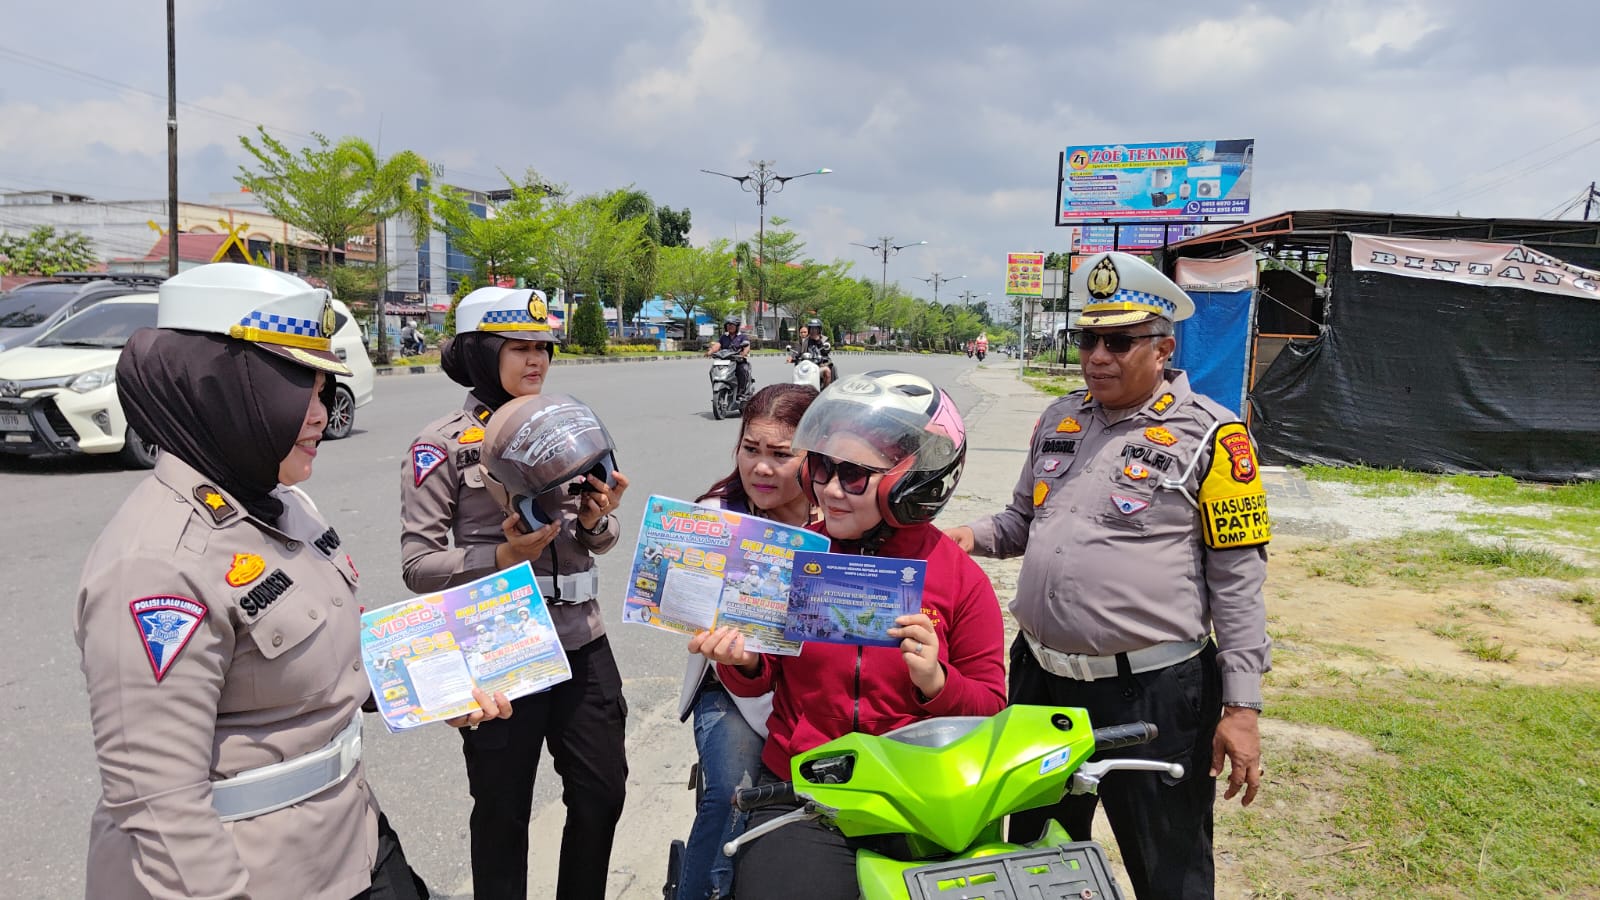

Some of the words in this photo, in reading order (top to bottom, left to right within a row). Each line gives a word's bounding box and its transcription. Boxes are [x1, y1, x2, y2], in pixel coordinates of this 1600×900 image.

[1091, 150, 1122, 163] ZOE
[1127, 147, 1187, 161] TEKNIK
[1371, 251, 1598, 292] BINTANG
[1121, 444, 1173, 471] POLRI
[661, 515, 724, 537] VIDEO
[1218, 531, 1247, 543] OMP
[134, 599, 160, 611] POLISI
[161, 598, 181, 607] LALU
[180, 601, 204, 615] LINTAS
[370, 608, 434, 639] VIDEO
